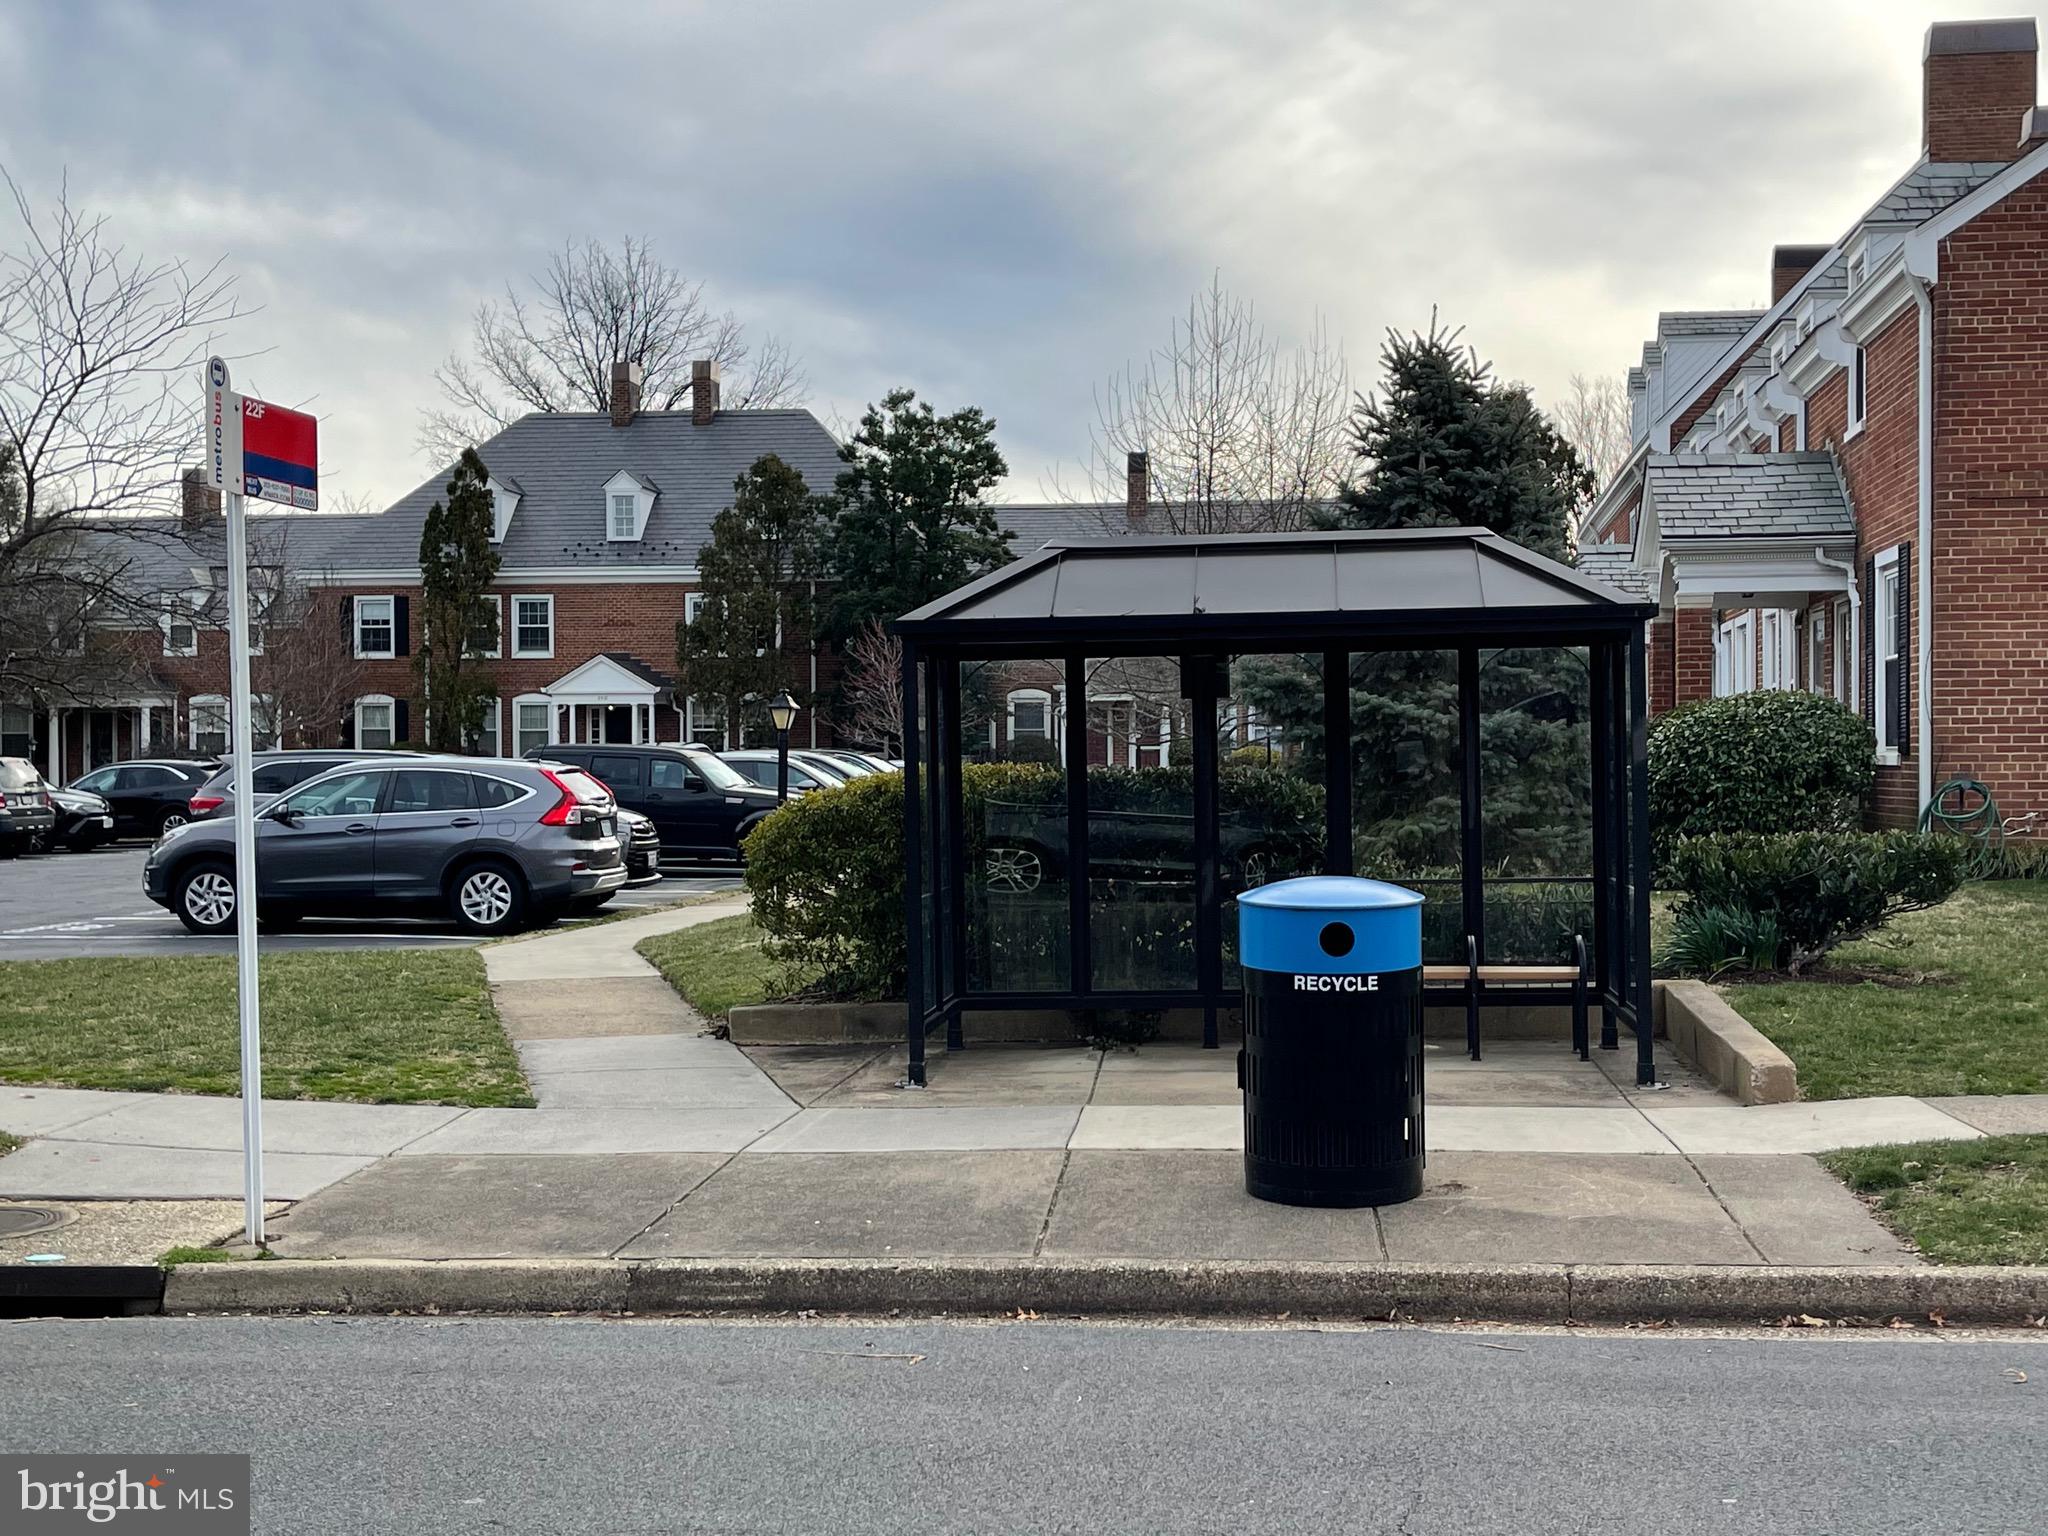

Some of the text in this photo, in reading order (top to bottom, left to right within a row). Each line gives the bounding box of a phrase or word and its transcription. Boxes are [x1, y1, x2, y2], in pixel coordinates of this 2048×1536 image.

[245, 401, 265, 418] 22F
[214, 391, 223, 483] metrobus
[1294, 975, 1378, 991] RECYCLE
